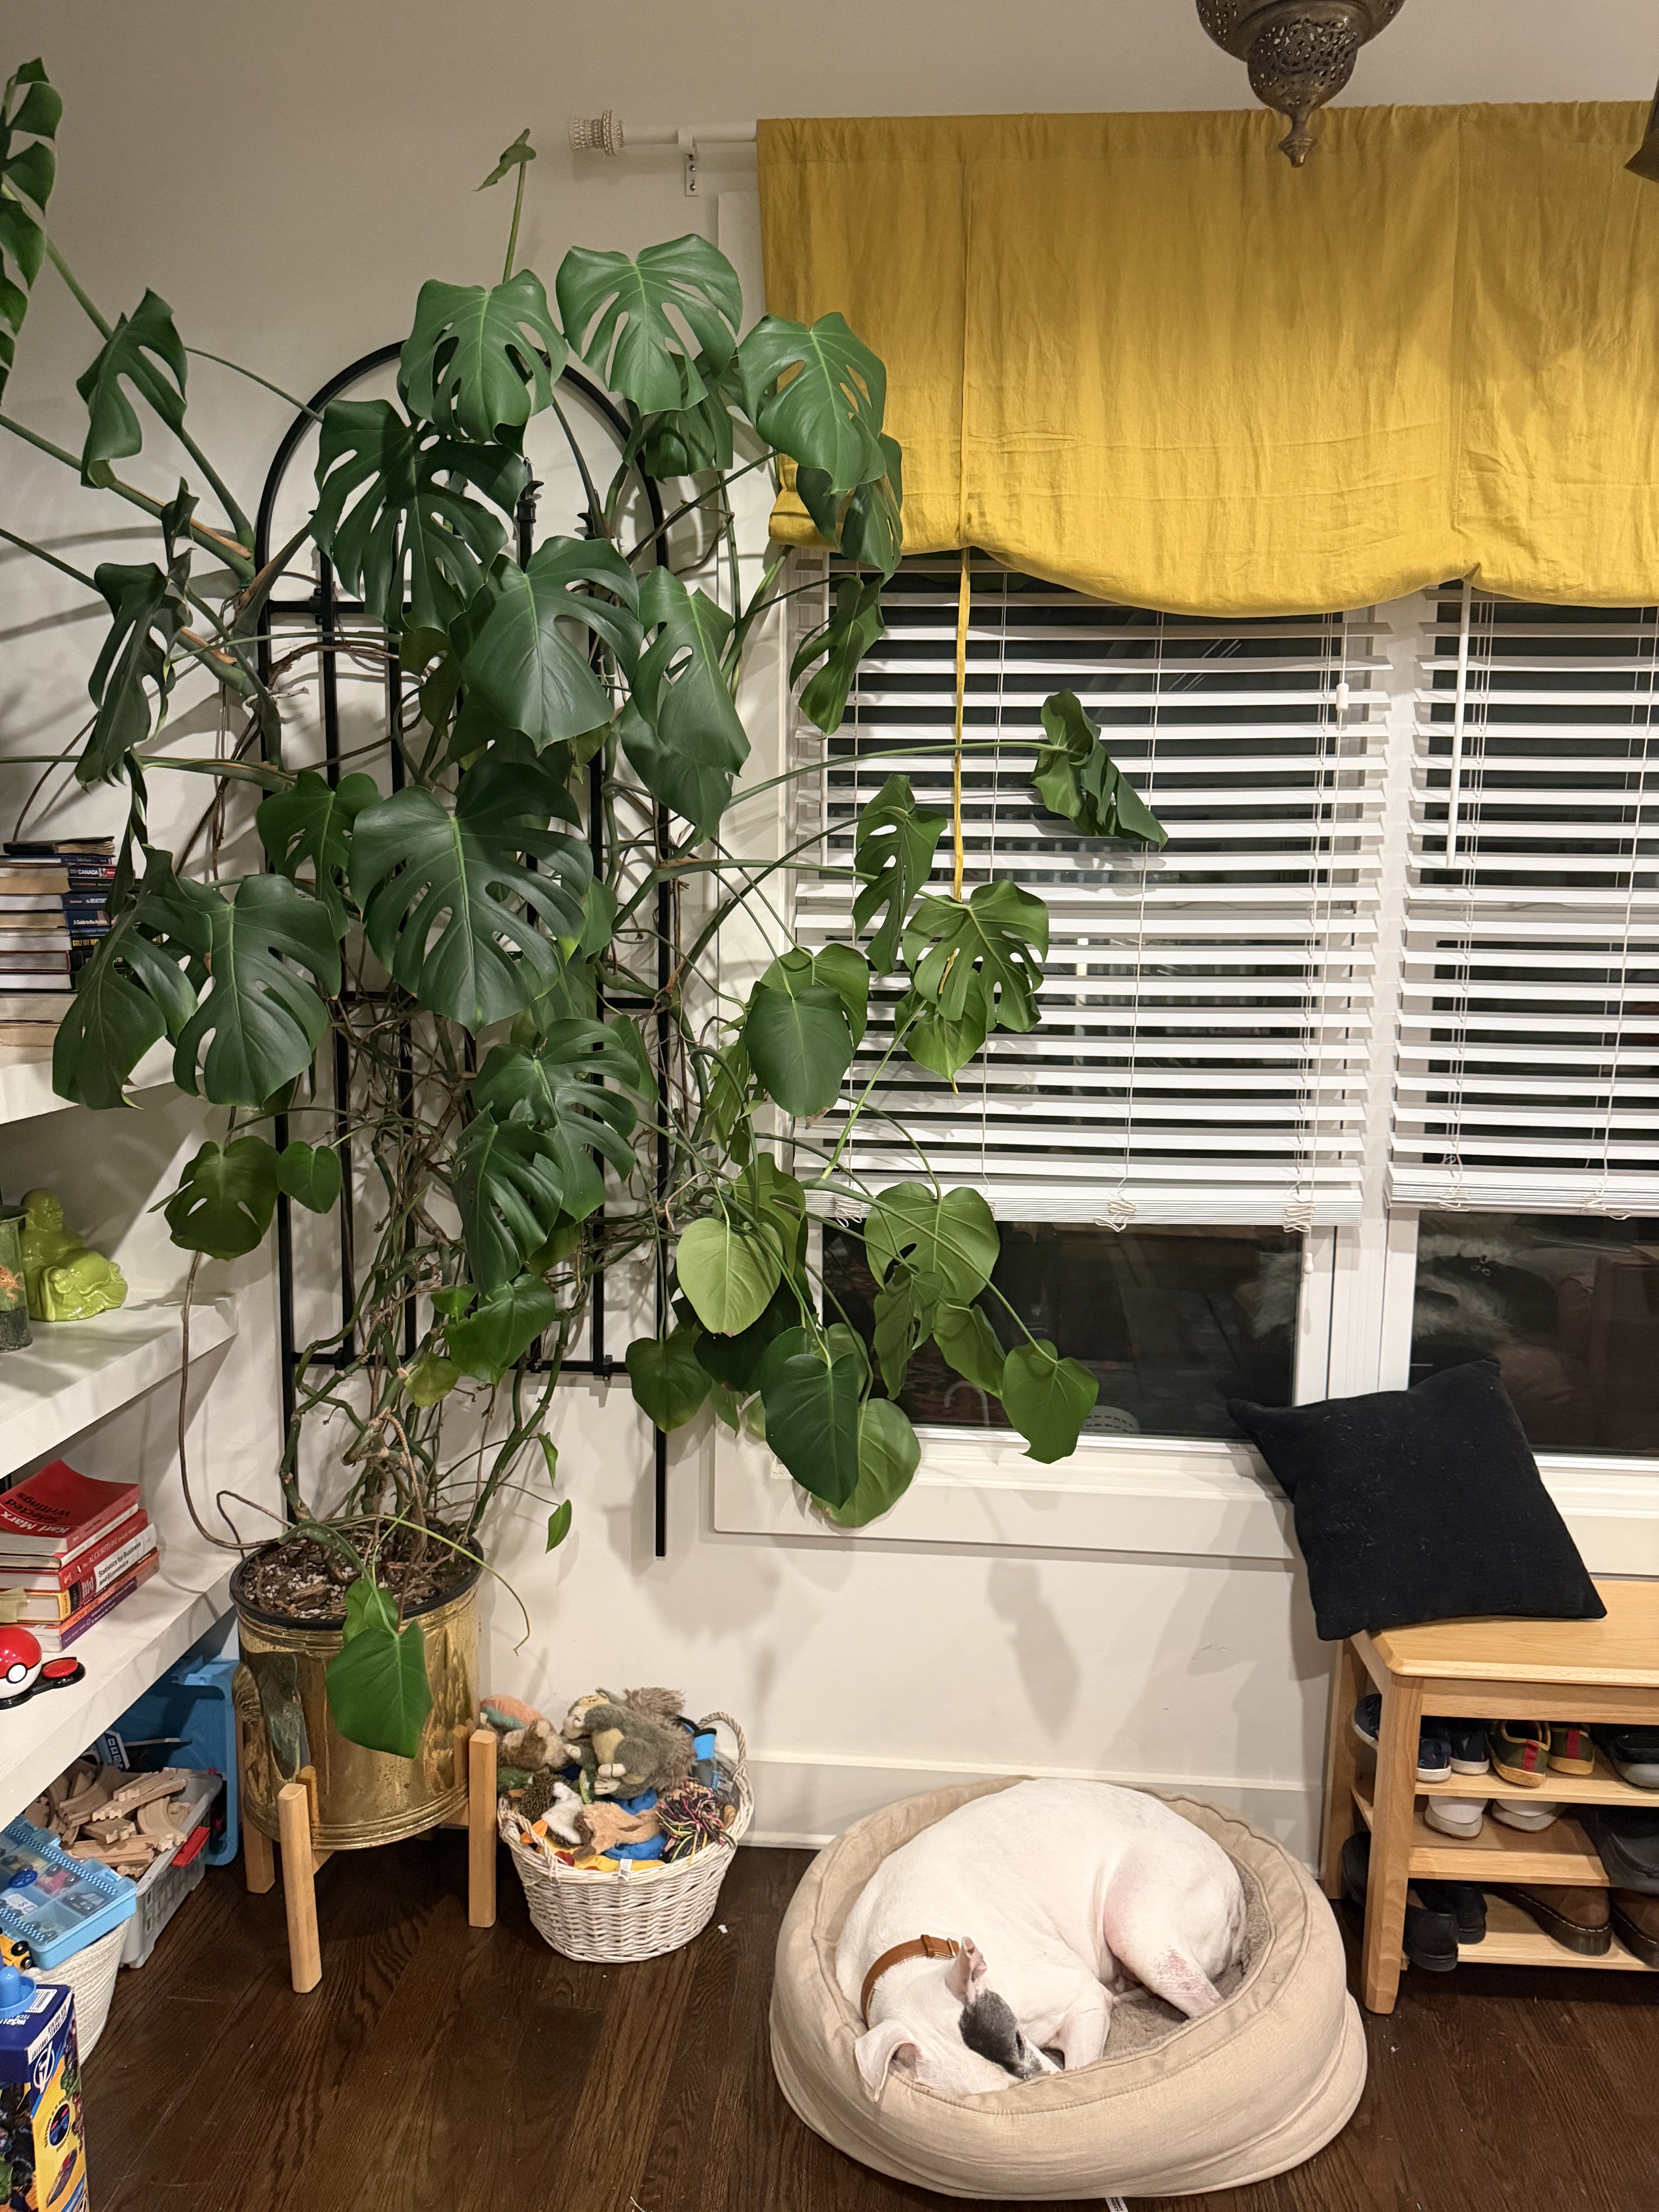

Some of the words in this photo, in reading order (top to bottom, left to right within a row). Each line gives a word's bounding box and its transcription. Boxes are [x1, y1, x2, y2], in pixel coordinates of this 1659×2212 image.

[5, 1498, 62, 1523] Selected
[16, 1492, 71, 1516] Writings
[0, 1511, 38, 1530] Marx
[37, 1525, 71, 1534] Karl
[98, 1560, 117, 1577] Statistics
[123, 1541, 141, 1557] Business
[99, 1575, 108, 1586] and
[107, 1560, 129, 1580] Economics
